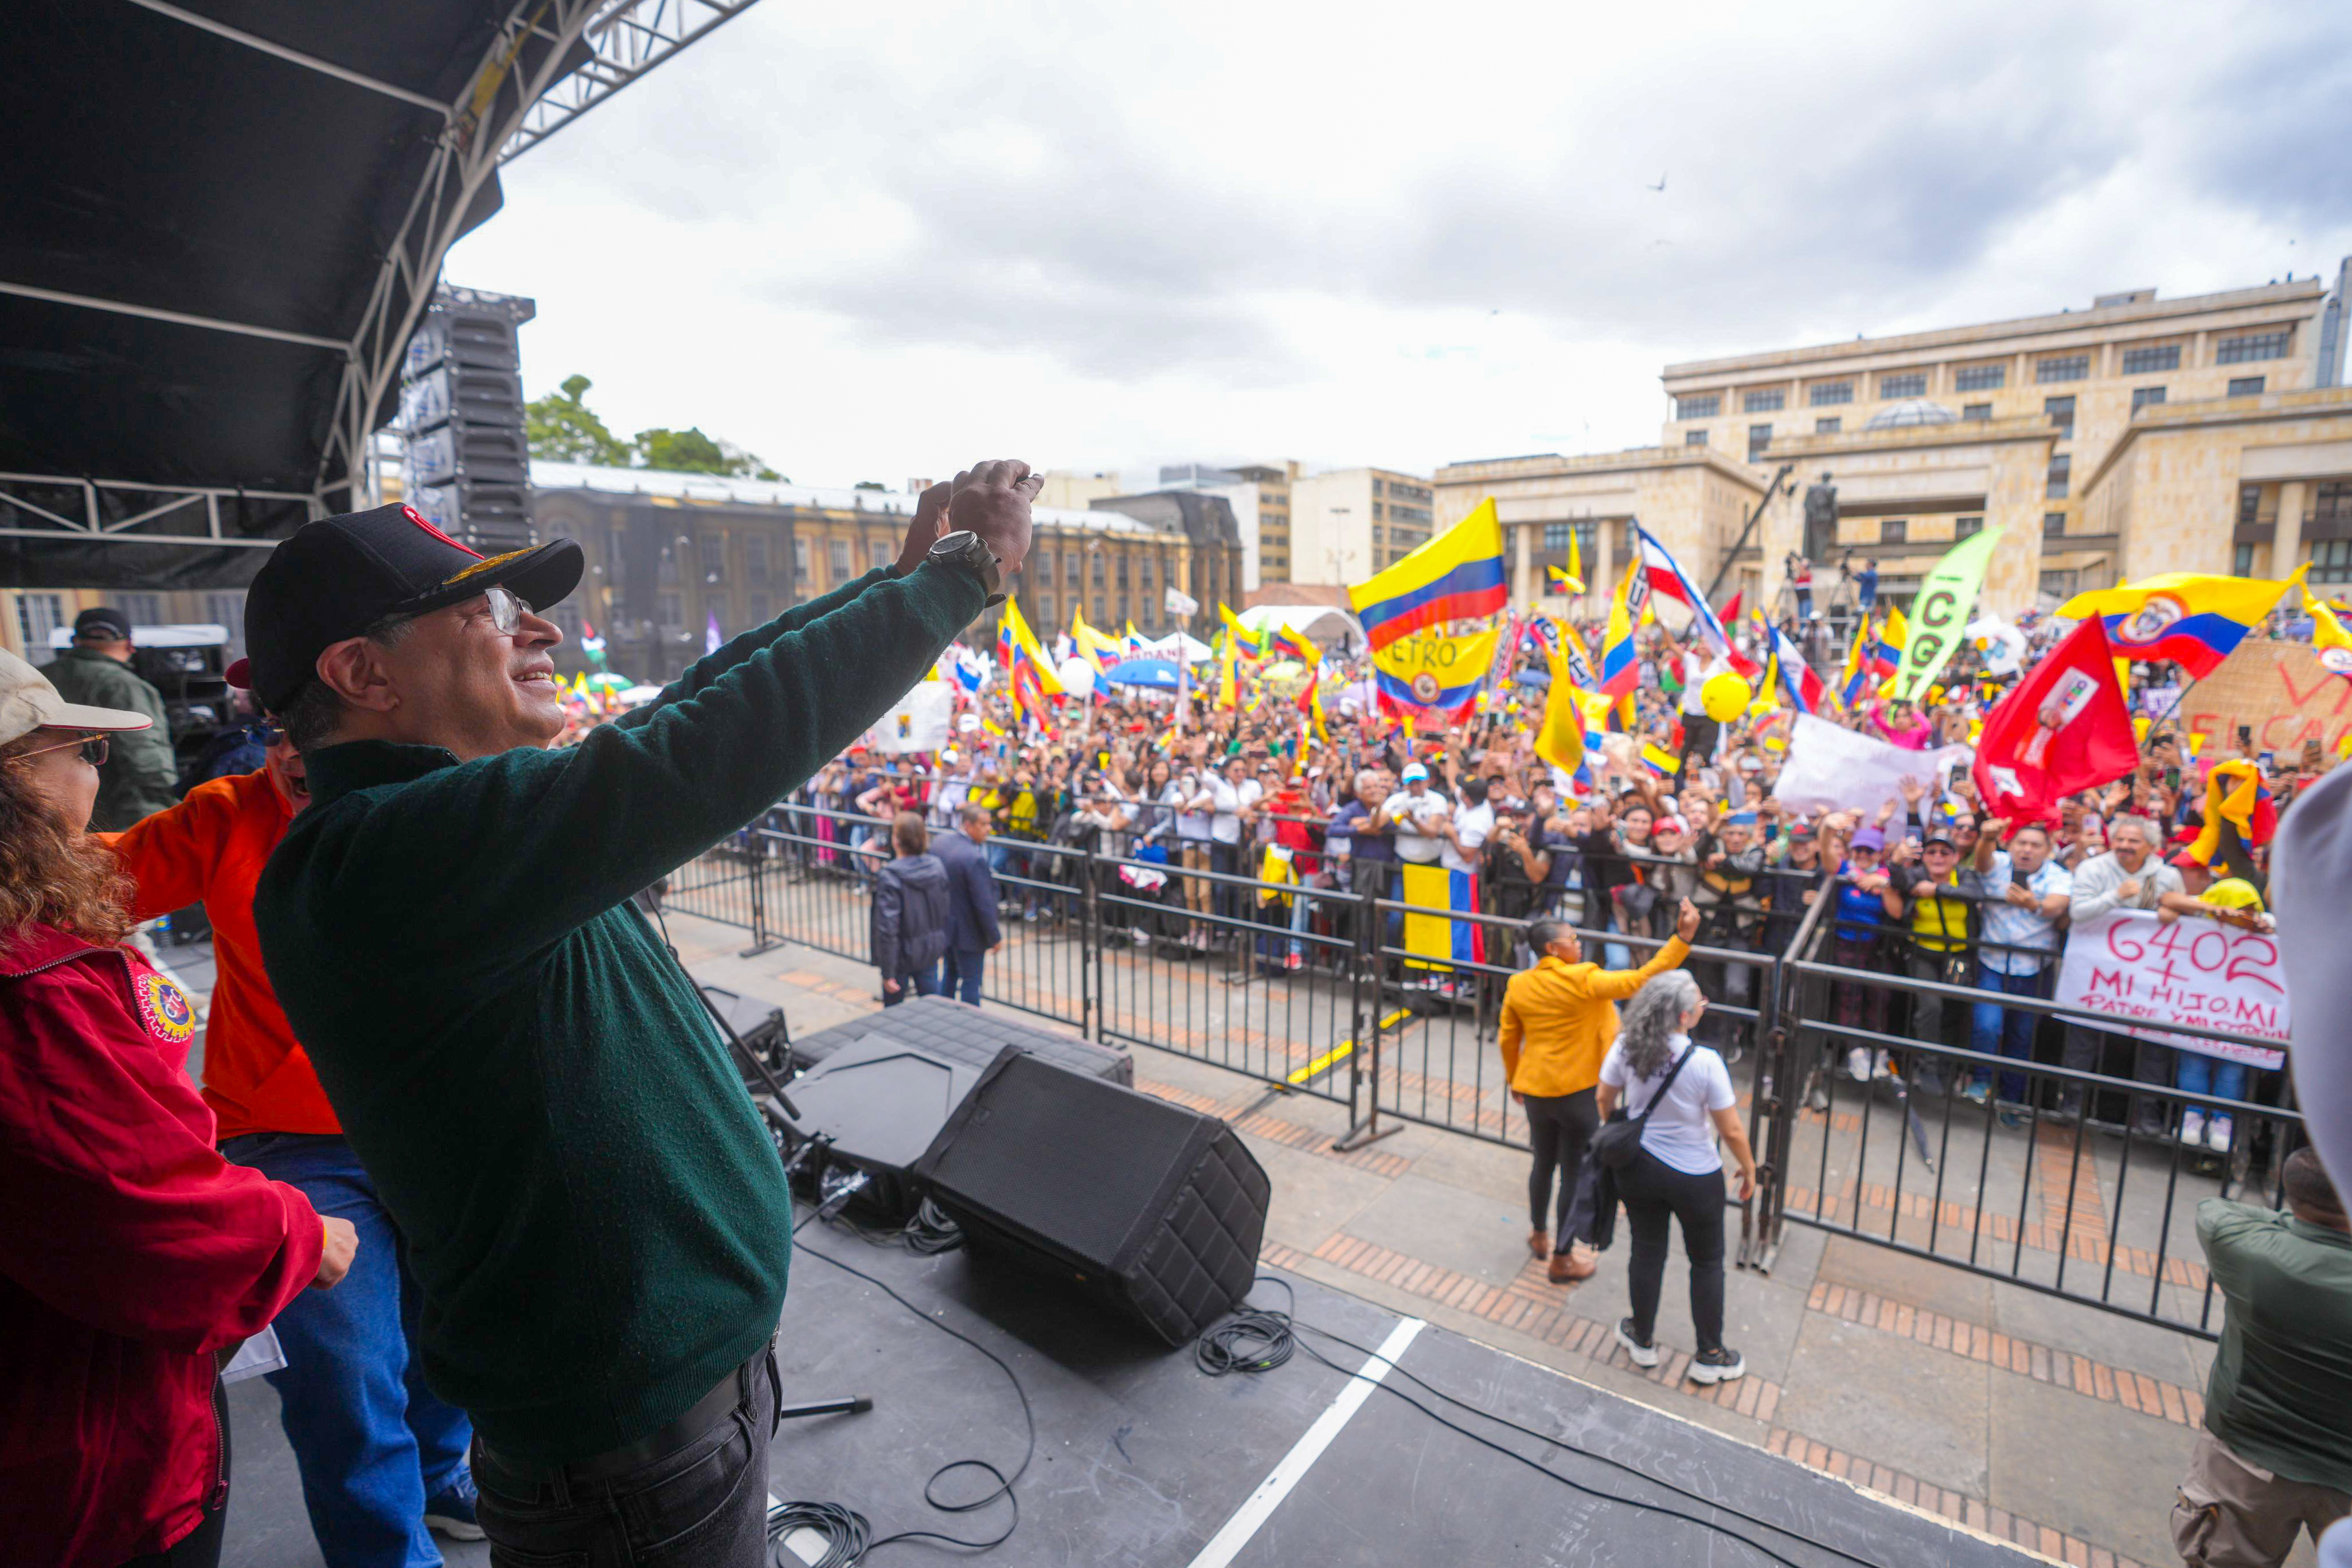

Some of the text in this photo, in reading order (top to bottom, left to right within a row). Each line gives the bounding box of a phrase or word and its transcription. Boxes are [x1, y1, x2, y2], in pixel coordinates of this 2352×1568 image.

[1382, 632, 1457, 667] ETRO
[2108, 918, 2284, 994] 6402
[165, 988, 182, 1018] CTC
[2090, 967, 2134, 996] MI
[2234, 997, 2276, 1027] MI
